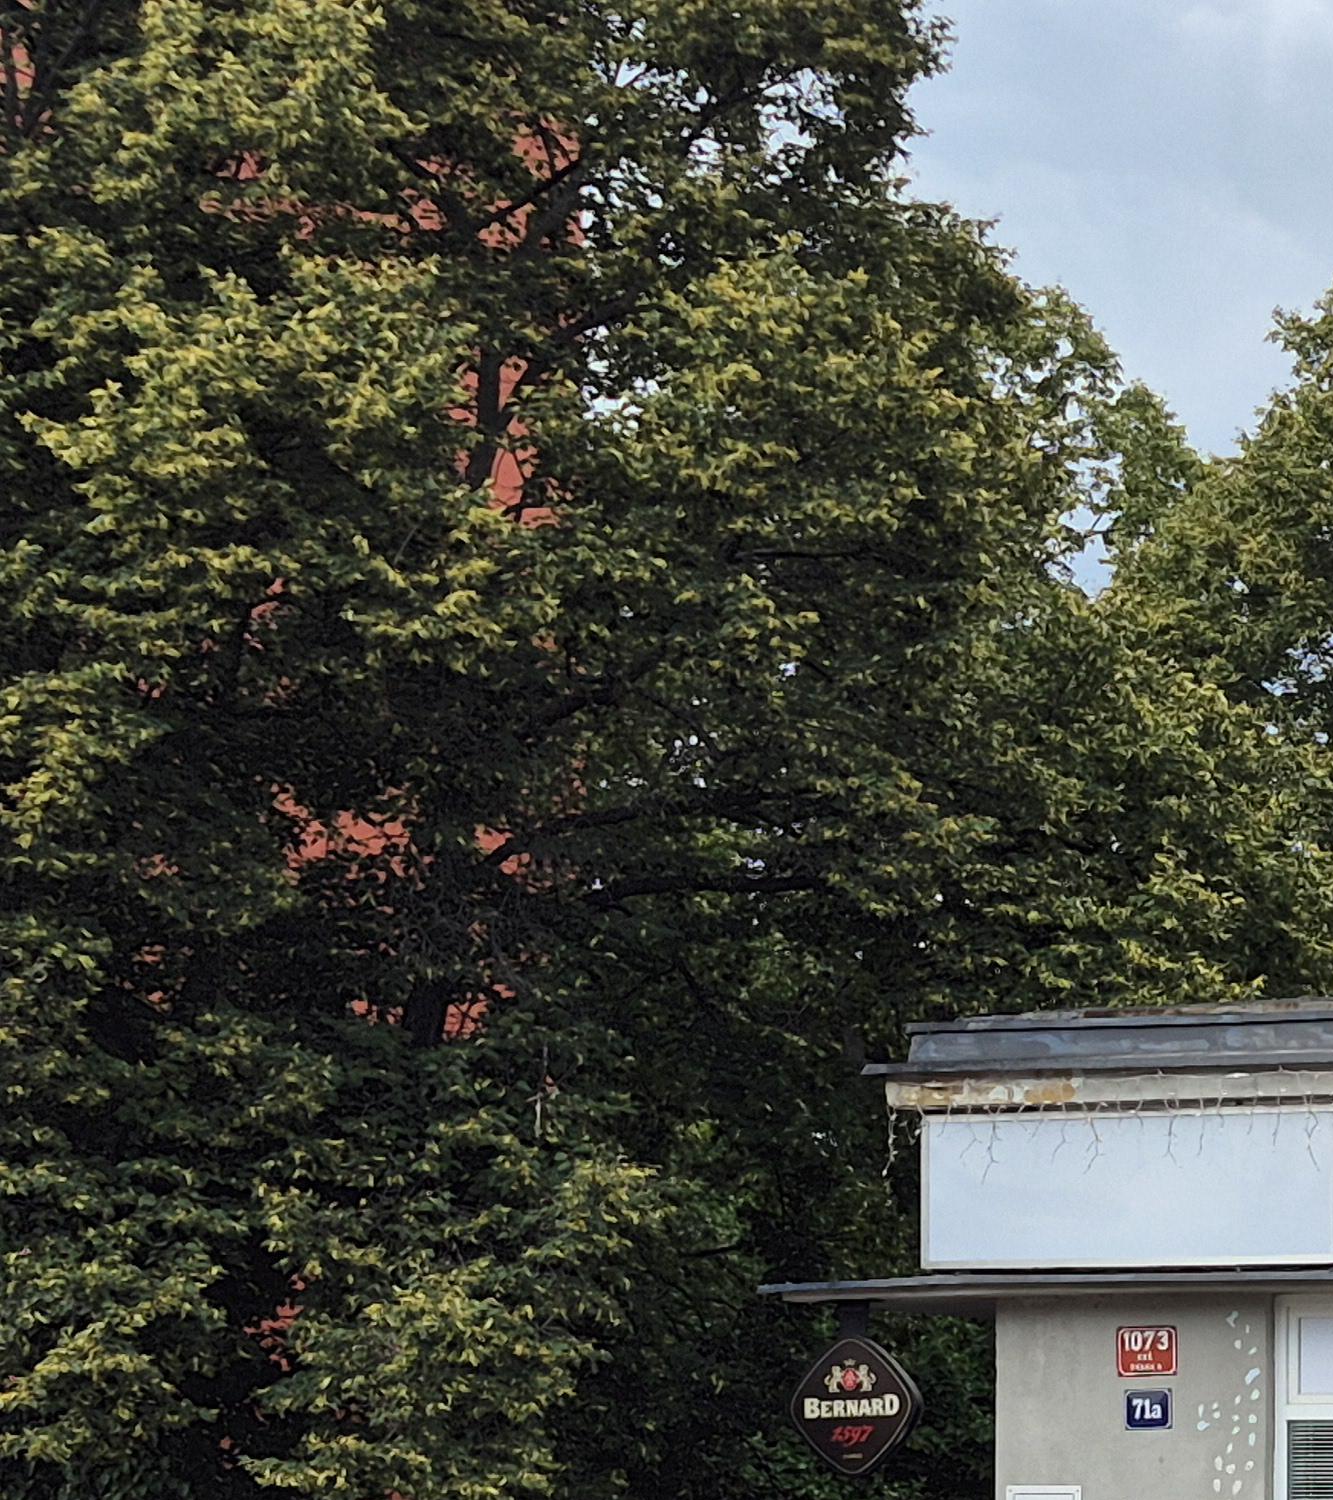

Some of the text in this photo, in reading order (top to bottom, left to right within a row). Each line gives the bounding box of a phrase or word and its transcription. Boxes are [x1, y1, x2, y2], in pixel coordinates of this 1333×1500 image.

[1123, 1330, 1169, 1351] 1073
[803, 1394, 900, 1419] BERNARD
[1132, 1398, 1163, 1420] 71a
[831, 1424, 875, 1447] 1597
